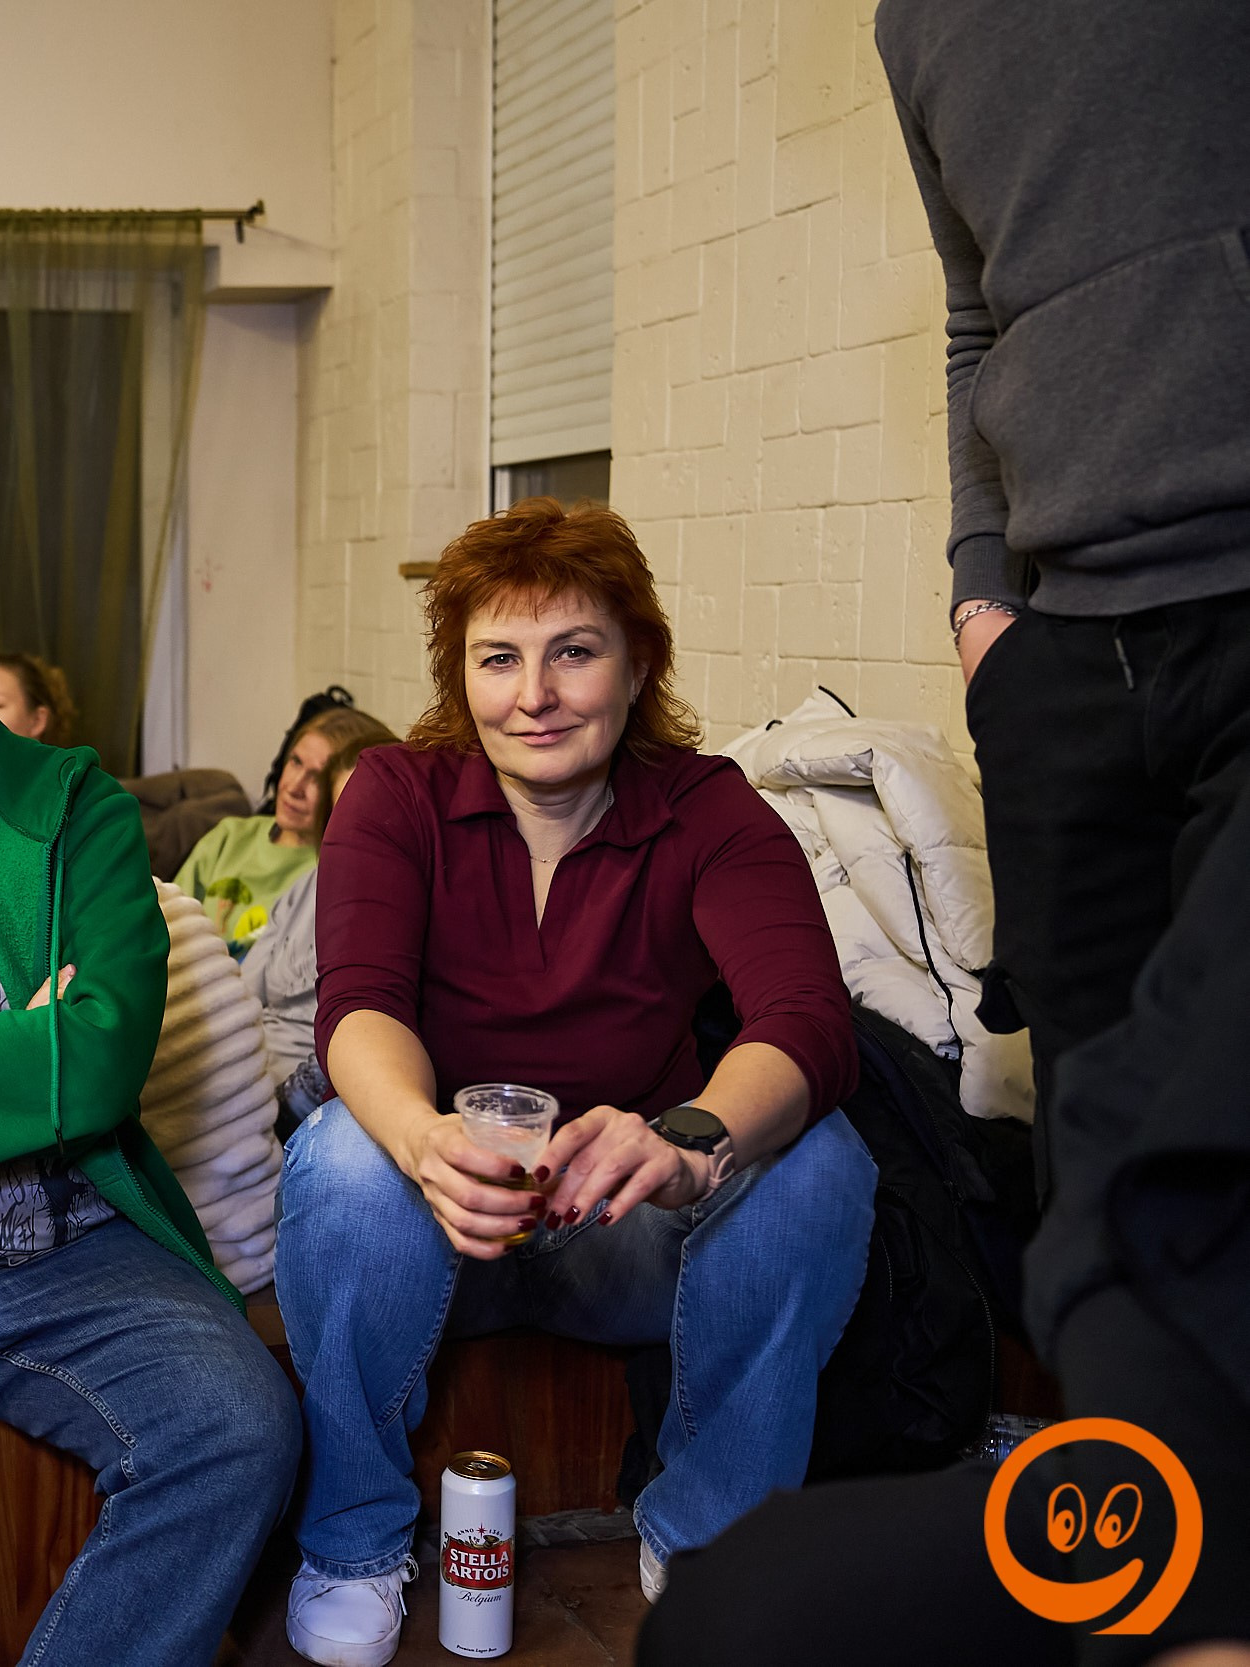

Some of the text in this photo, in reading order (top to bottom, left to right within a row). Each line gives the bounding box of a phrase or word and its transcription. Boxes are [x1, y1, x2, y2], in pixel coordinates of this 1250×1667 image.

[457, 1528, 474, 1536] ANNO
[450, 1548, 509, 1566] STELLA
[449, 1563, 509, 1580] ARTOIS
[456, 1591, 502, 1607] Belgium
